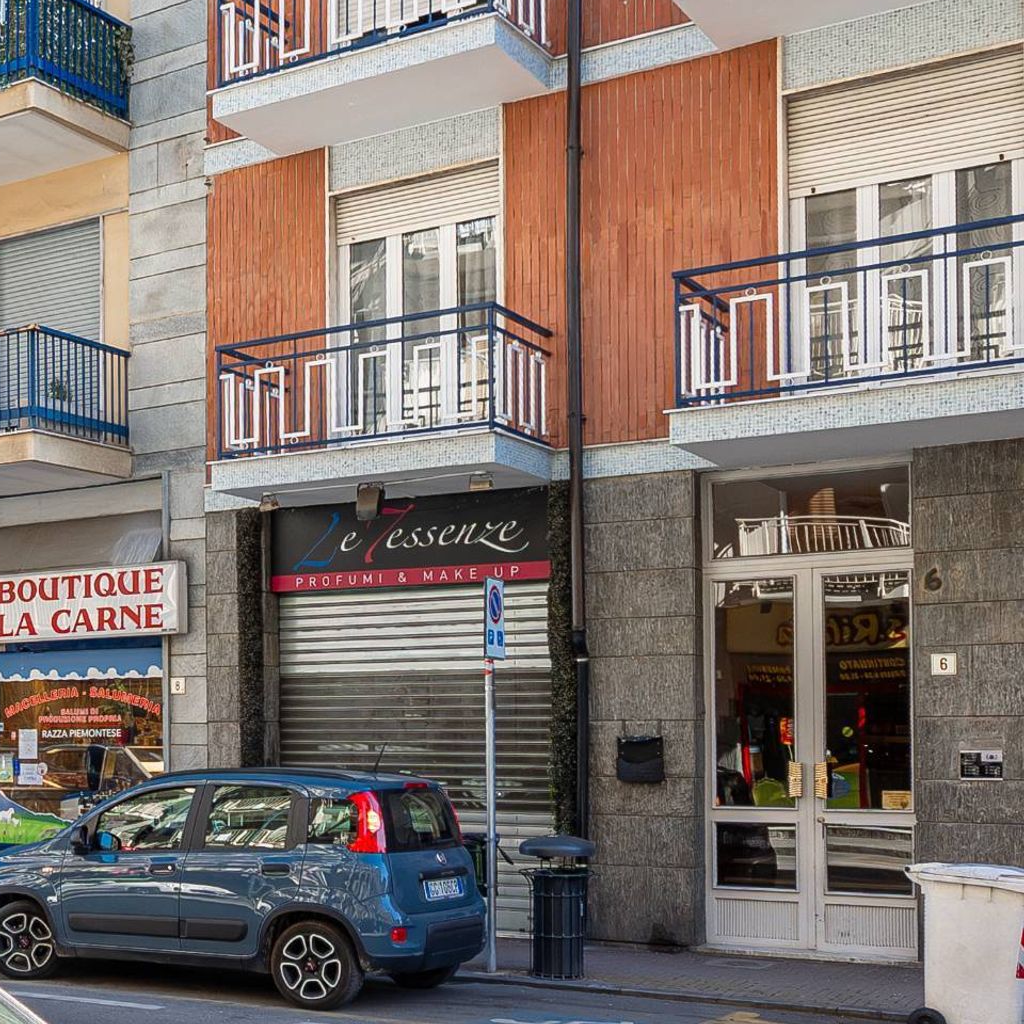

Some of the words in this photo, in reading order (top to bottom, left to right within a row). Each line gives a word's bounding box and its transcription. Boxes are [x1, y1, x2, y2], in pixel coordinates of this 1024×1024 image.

[295, 573, 384, 588] PROFUMI
[397, 571, 408, 583] &
[422, 568, 478, 582] MAKE
[493, 565, 520, 578] UP
[924, 567, 943, 592] 6
[50, 603, 164, 634] CARNE
[939, 657, 949, 671] 6
[174, 680, 181, 691] 8
[4, 686, 79, 719] MACELLERIA
[89, 686, 161, 716] SALUMERIA
[60, 707, 89, 716] SALUMI
[90, 707, 99, 716] DI
[38, 715, 87, 724] PRODUZIONE
[88, 714, 122, 723] PROPRIA
[41, 729, 68, 739] RAZZA
[69, 728, 122, 738] PIEMONTESE
